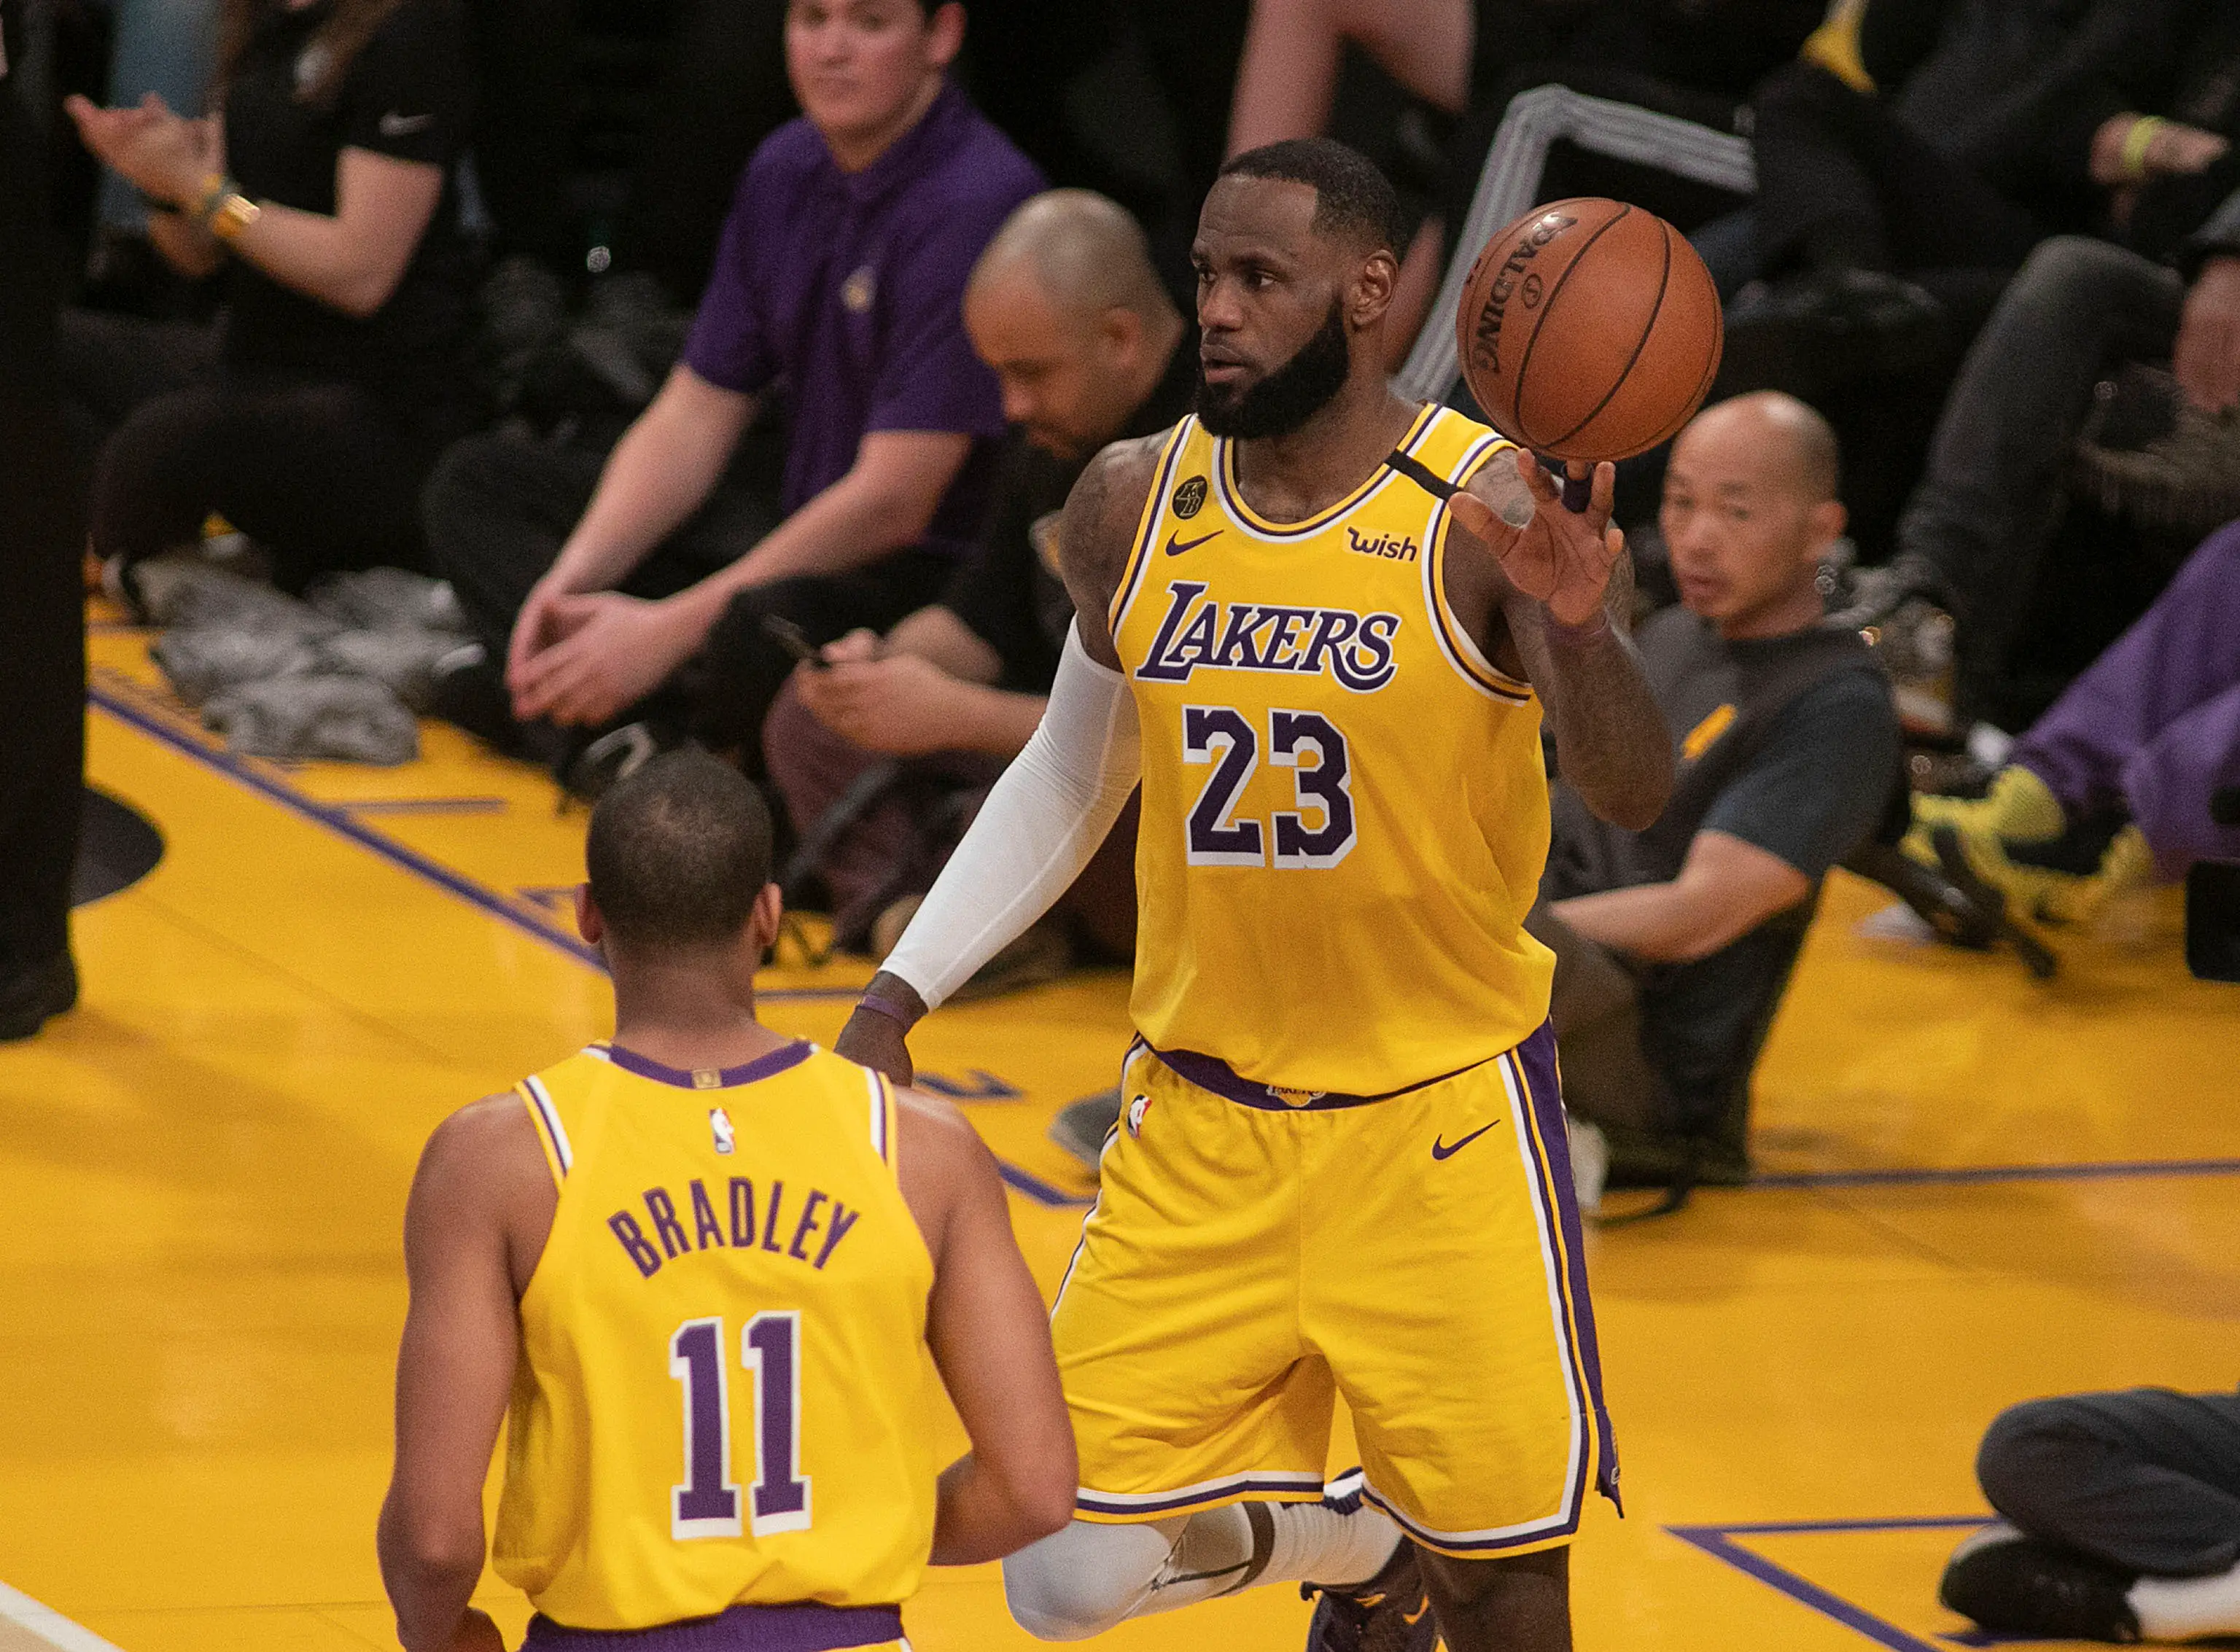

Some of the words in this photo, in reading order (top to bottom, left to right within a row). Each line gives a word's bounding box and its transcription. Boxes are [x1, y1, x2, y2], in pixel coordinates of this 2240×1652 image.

[1348, 526, 1417, 561] wish
[1135, 580, 1401, 693] LAKERS
[1181, 705, 1357, 869] 23
[607, 1177, 860, 1279] BRADLEY
[669, 1311, 812, 1540] 11
